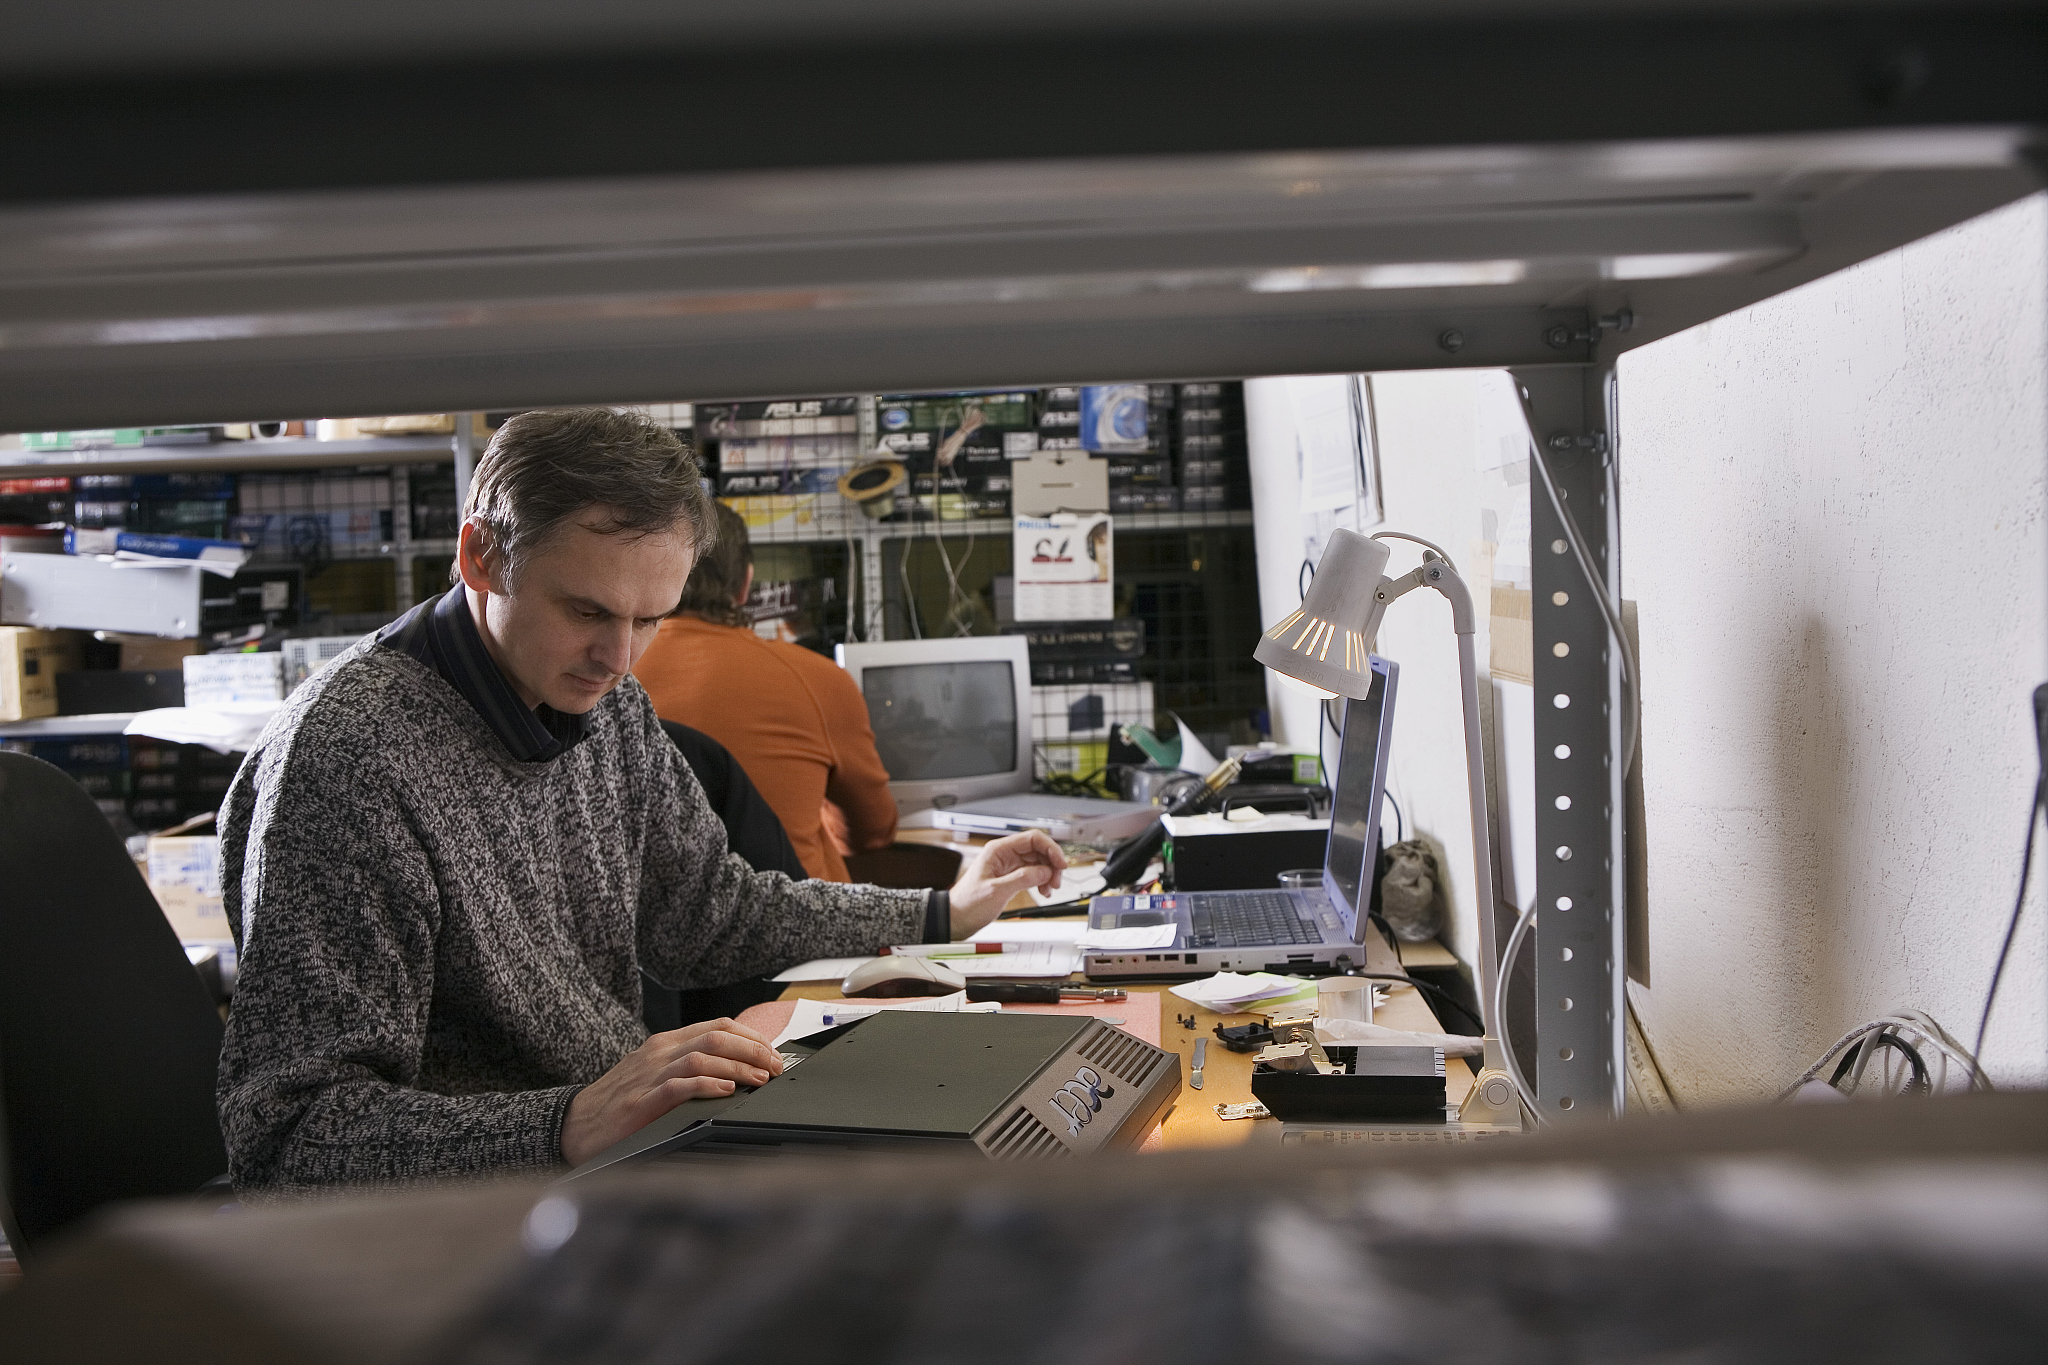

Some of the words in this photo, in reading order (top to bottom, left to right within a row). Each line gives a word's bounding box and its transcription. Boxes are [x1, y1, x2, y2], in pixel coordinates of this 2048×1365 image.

[762, 401, 822, 420] ASUS
[1303, 667, 1324, 682] R50
[1048, 1066, 1115, 1138] acer
